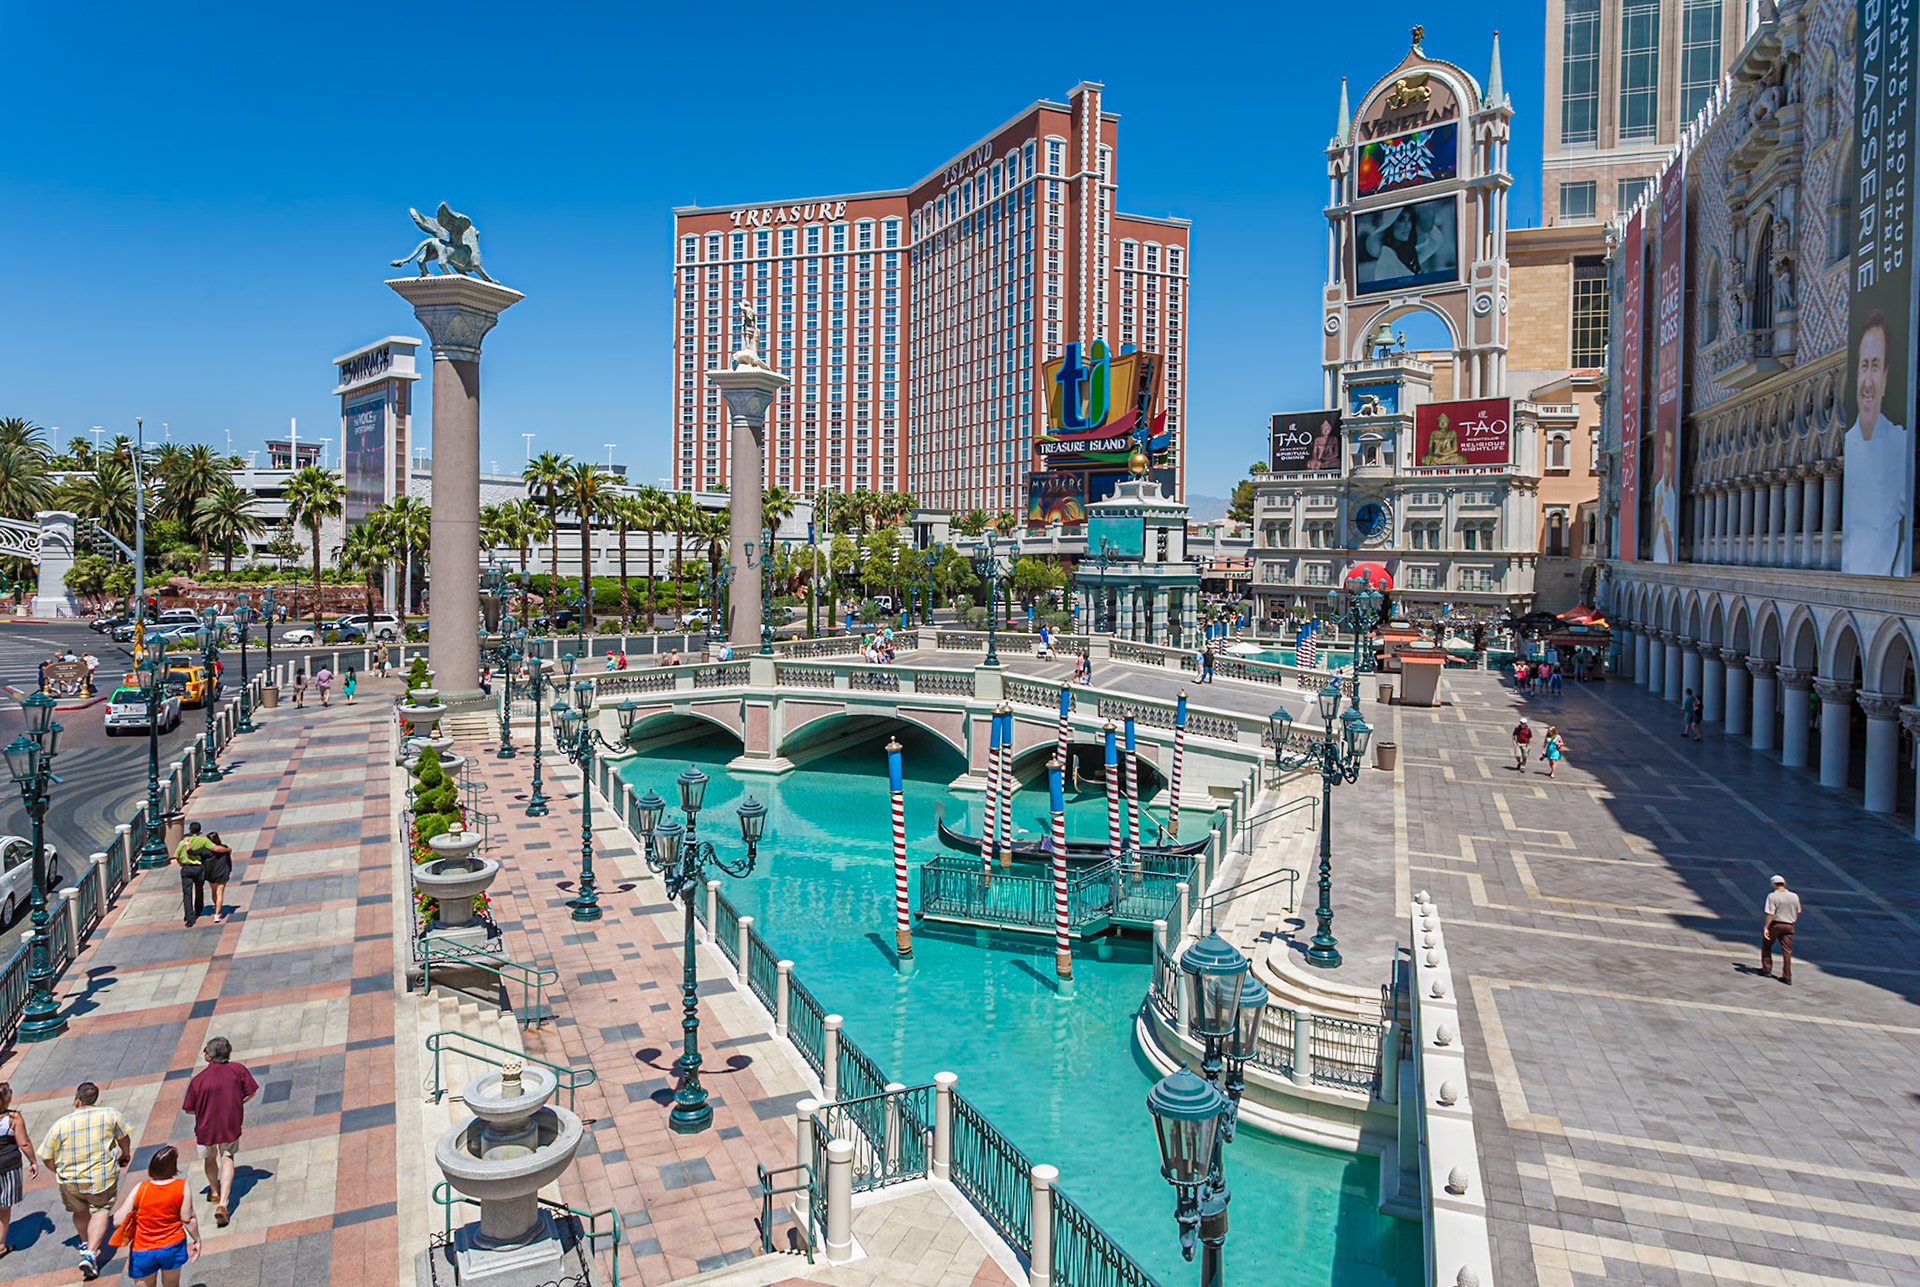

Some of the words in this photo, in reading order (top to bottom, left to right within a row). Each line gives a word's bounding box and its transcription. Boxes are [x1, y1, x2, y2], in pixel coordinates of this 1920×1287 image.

[1888, 56, 1897, 97] TO
[1360, 104, 1456, 140] VENETIAN
[1378, 130, 1435, 171] ROCK
[1857, 0, 1881, 292] BRASSERIE
[1886, 110, 1896, 172] THE
[942, 141, 993, 188] ISLAND
[1377, 157, 1435, 191] AGES
[729, 201, 847, 227] TREASURE
[1894, 129, 1907, 268] BOULUD
[1884, 186, 1894, 273] STRIP
[1661, 287, 1678, 320] CAKE
[1660, 313, 1678, 347] BOSS
[1040, 441, 1085, 454] TREASURE
[1089, 439, 1126, 452] ISLAND
[1274, 431, 1312, 447] TAO
[1458, 420, 1508, 437] TAO
